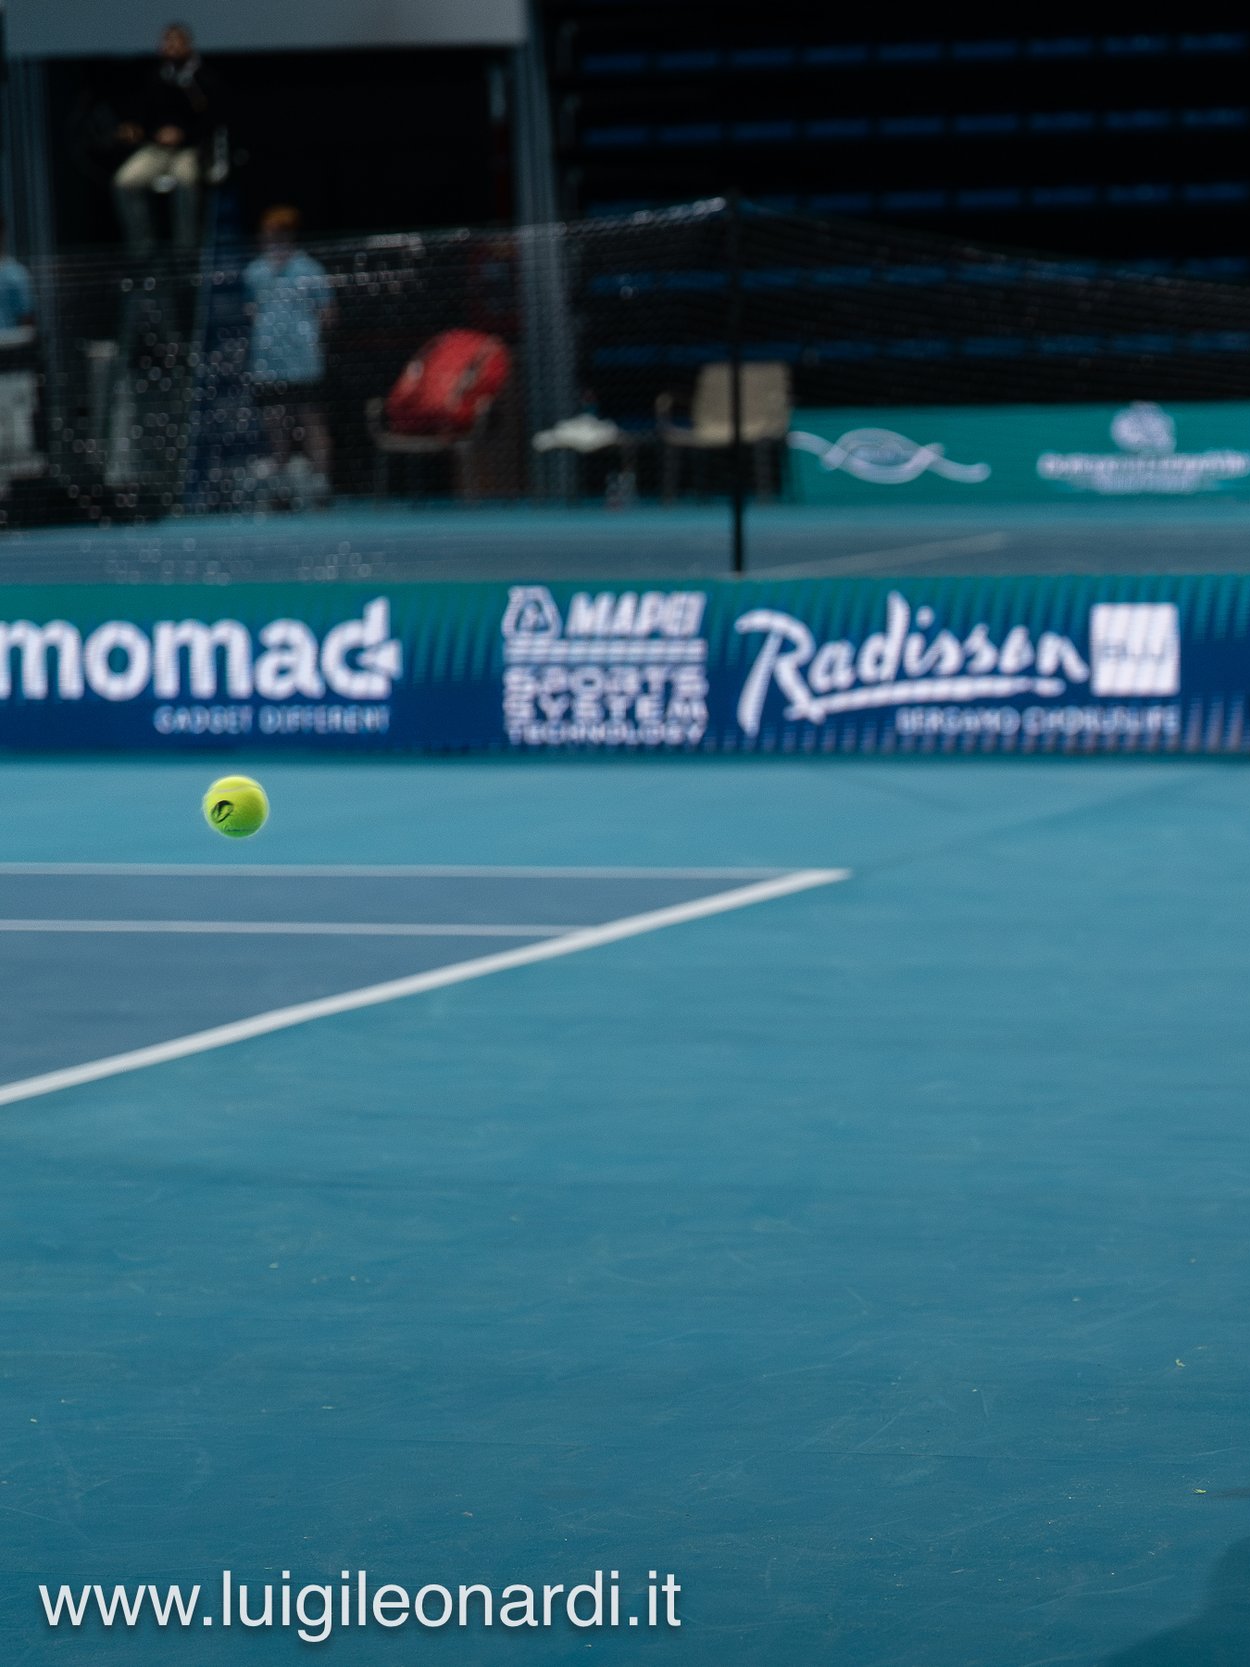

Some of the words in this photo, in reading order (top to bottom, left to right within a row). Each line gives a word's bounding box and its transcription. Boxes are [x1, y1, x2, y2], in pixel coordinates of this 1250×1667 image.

[564, 591, 707, 637] MAPEI
[502, 666, 709, 696] SPORTS
[734, 590, 1090, 738] Radisson
